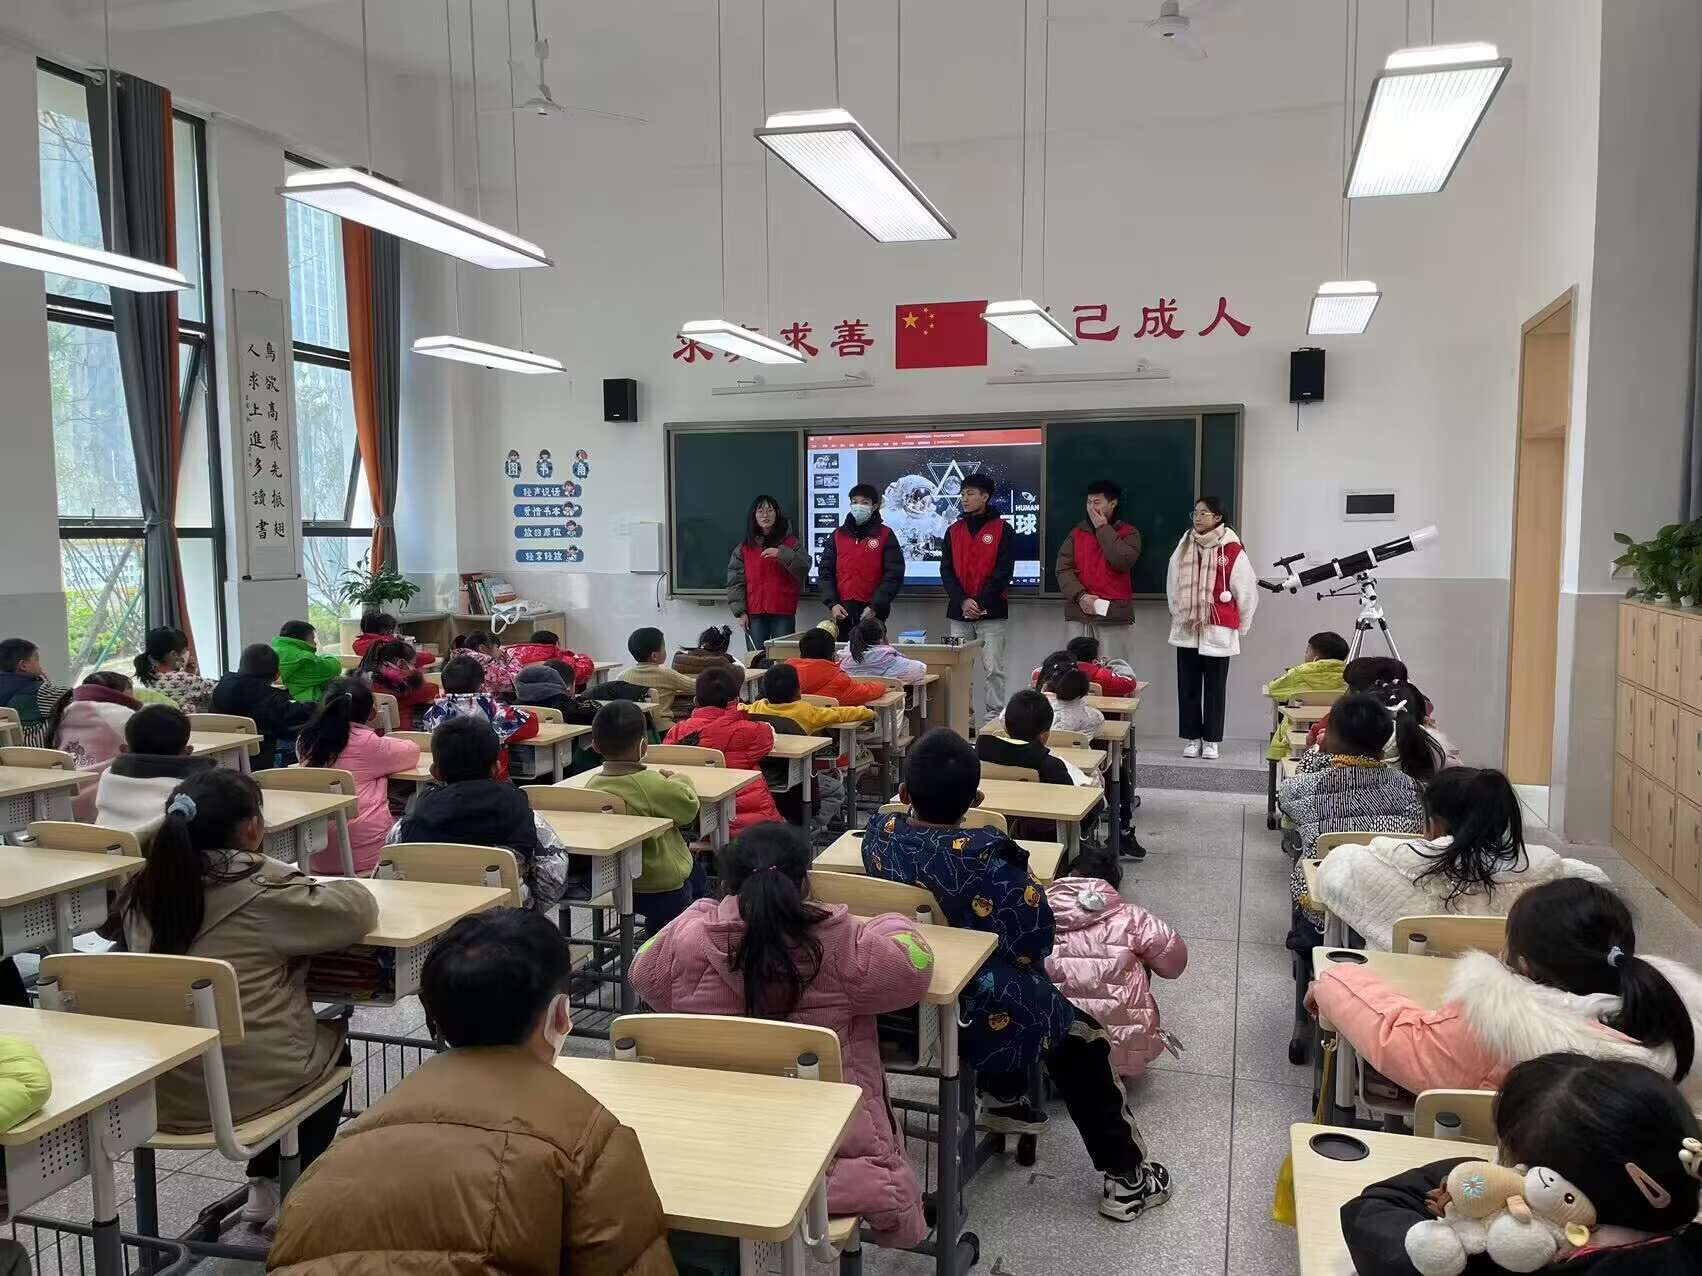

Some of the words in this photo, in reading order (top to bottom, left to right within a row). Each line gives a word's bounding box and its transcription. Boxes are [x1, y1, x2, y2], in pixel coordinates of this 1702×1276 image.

[673, 318, 875, 363] 求求善
[1010, 296, 1252, 344] 己成人
[247, 343, 270, 540] 人求上進多讀書
